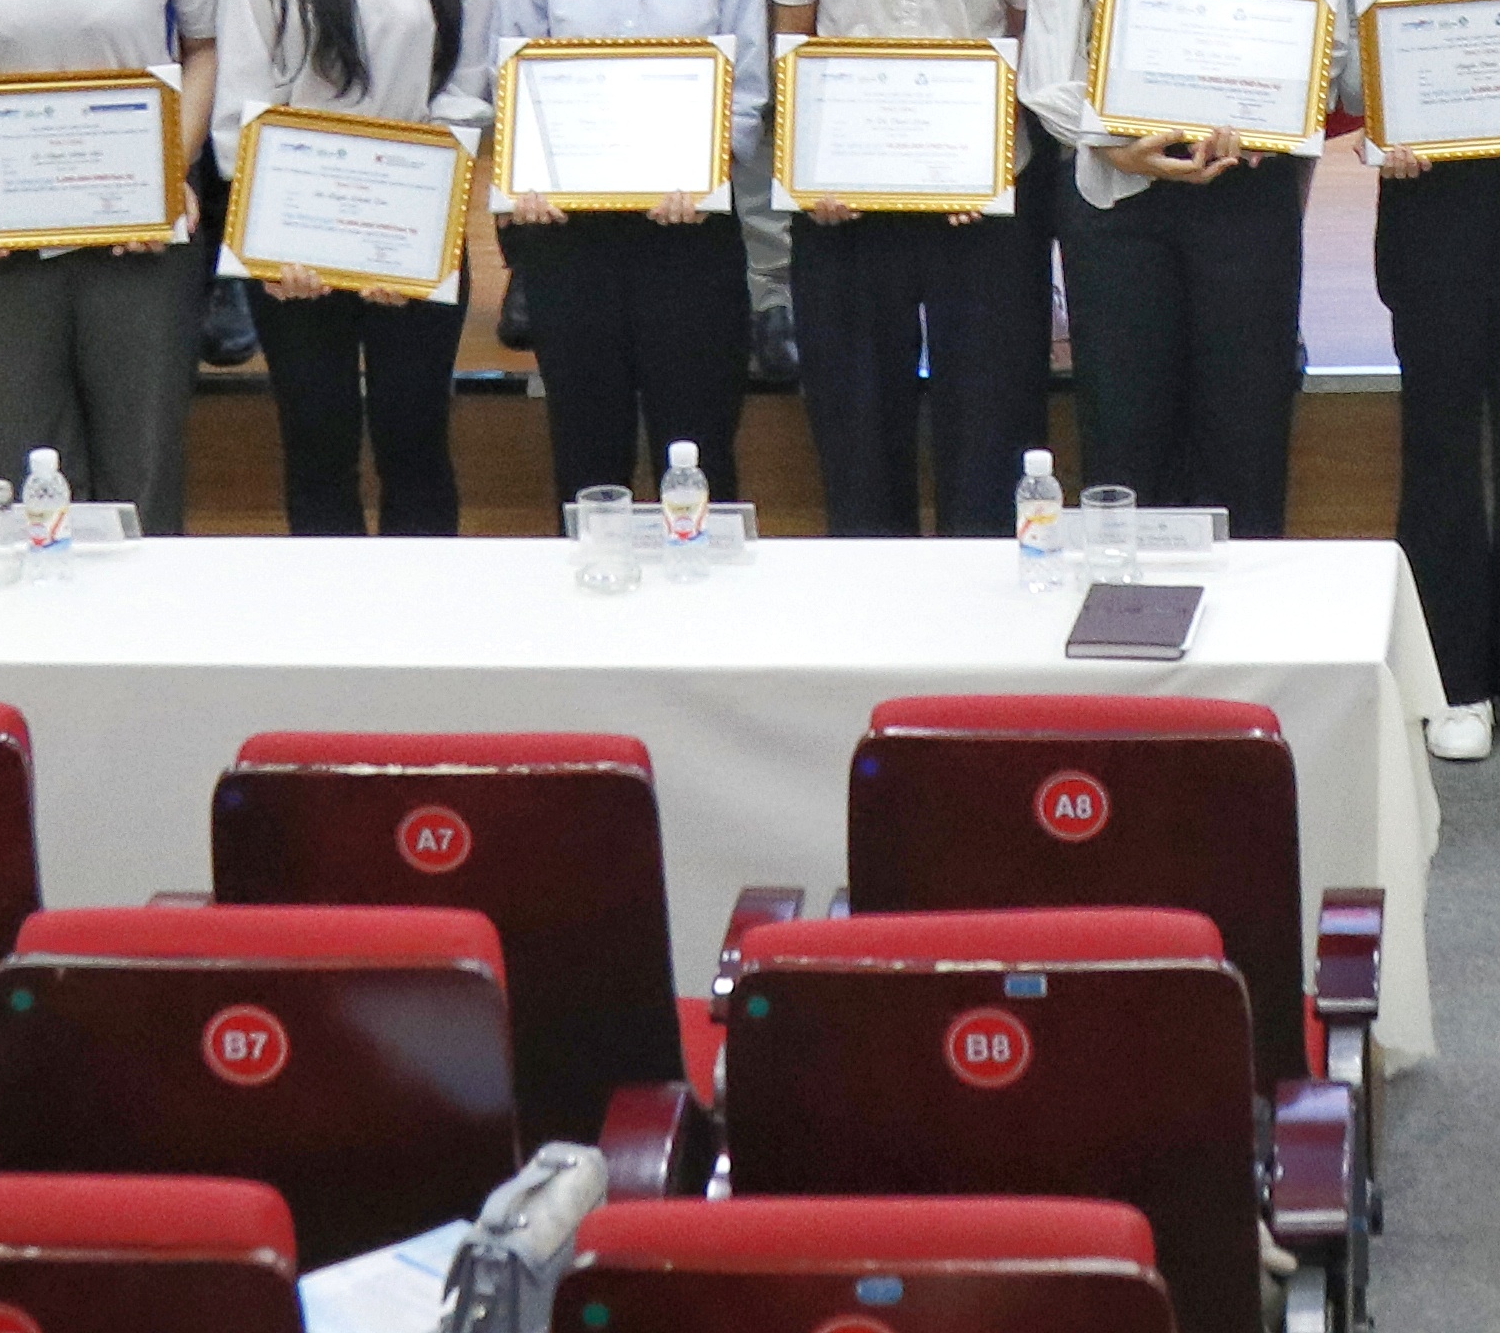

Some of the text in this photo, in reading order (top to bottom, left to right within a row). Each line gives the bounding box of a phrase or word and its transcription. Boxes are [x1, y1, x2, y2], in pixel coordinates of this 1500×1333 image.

[1052, 793, 1091, 819] A8
[413, 826, 452, 852] A7
[222, 1030, 269, 1062] B7
[966, 1032, 1012, 1062] B8
